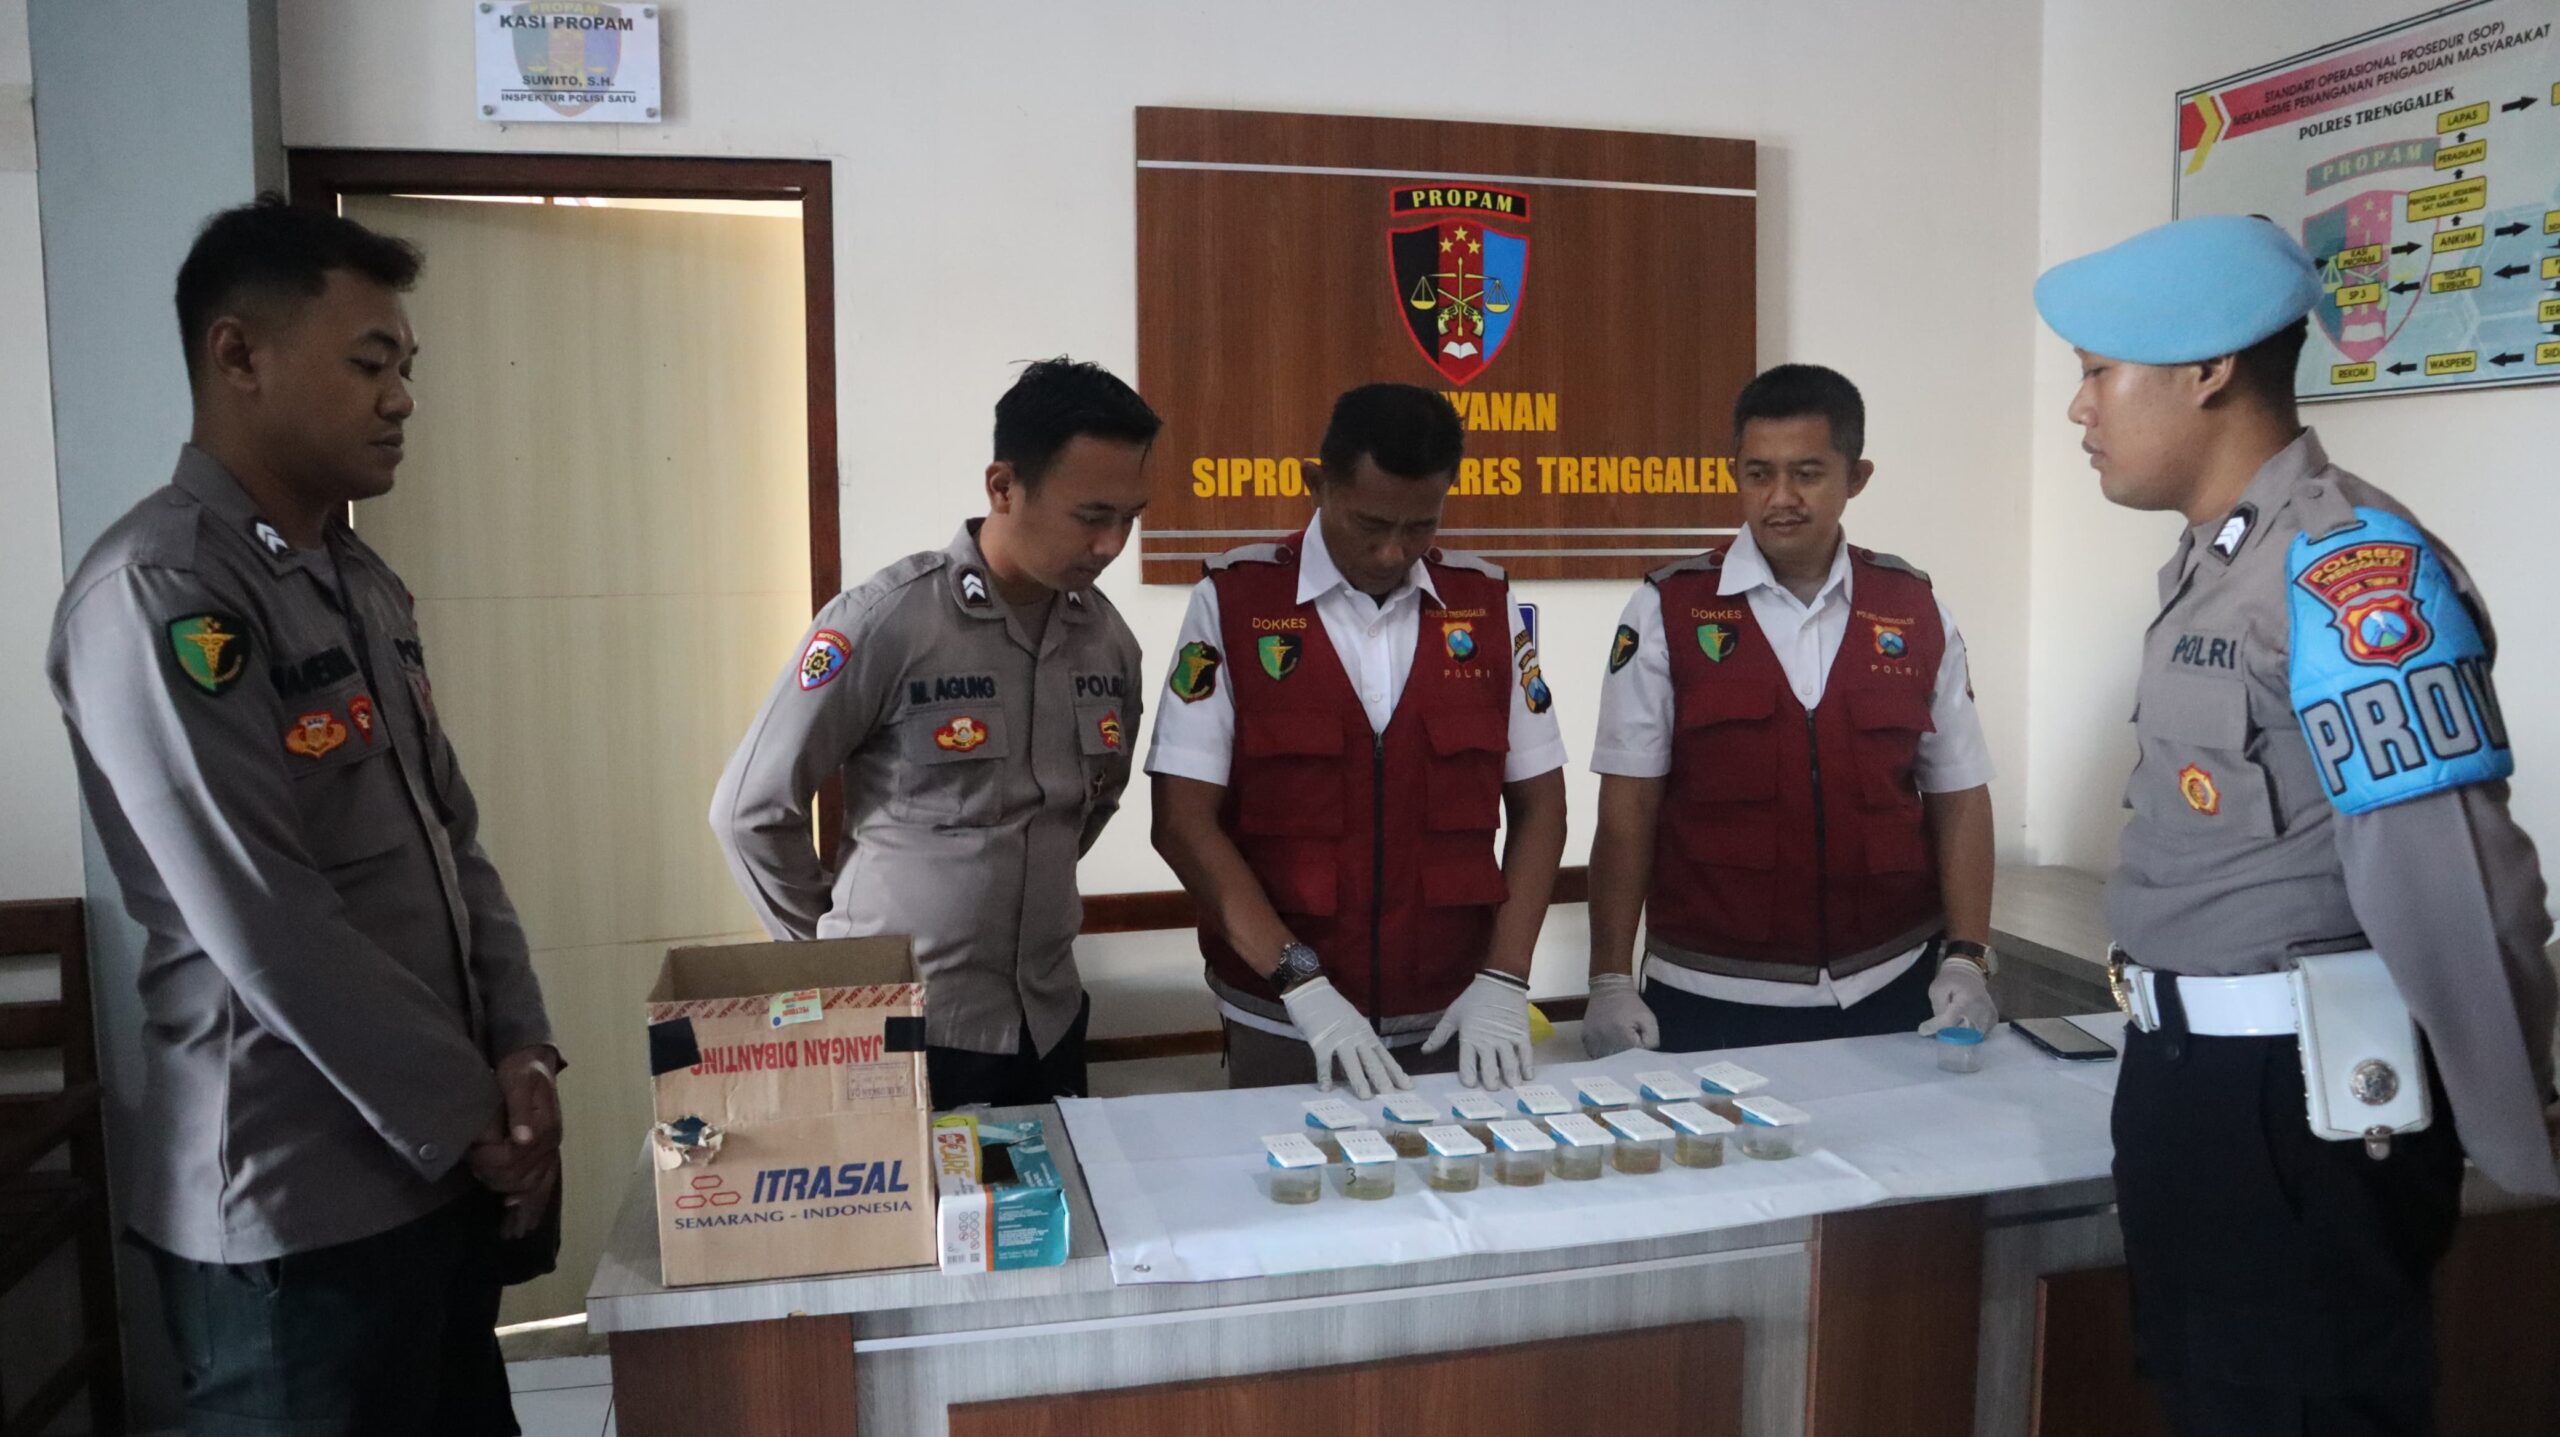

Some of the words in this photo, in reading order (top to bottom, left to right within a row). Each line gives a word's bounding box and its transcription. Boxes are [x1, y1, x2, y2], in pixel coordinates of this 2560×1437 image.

[500, 15, 546, 29] KASI
[553, 16, 634, 32] PROPAM
[2232, 100, 2291, 127] MEKANISME
[2294, 78, 2374, 110] PENANGANAN
[2376, 54, 2455, 86] PENGADUAN
[2457, 23, 2552, 63] MASYARAKAT
[2264, 78, 2316, 104] STANDART
[2317, 54, 2397, 88] OPERASIONAL
[2400, 32, 2464, 63] PROSEDUR
[2467, 20, 2506, 44] (SOP)
[522, 75, 583, 88] SUWITO,
[587, 76, 615, 87] S.H.
[501, 93, 566, 103] INSPEKTUR
[568, 94, 604, 103] POLISI
[607, 94, 637, 104] SATU
[2298, 114, 2353, 141] POLRES
[2355, 85, 2456, 126] TRENGGALEK
[2447, 109, 2479, 126] LAPAS
[2322, 142, 2423, 181] PROPAM
[1412, 188, 1514, 213] PROPAM
[1440, 390, 1557, 431] YANAN
[1192, 456, 1321, 497] SIPRO
[1536, 455, 1739, 494] TRENGGALEK
[2309, 547, 2406, 583] POLRES
[1252, 617, 1308, 631] DOKKES
[1691, 607, 1743, 620] DOKKES
[2171, 634, 2237, 670] POLRI
[1444, 669, 1490, 679] POLRI
[1870, 664, 1919, 677] POLRI
[803, 1034, 883, 1068] JANGAN
[751, 1159, 910, 1205] ITRASAL
[1345, 1167, 1357, 1186] 3
[674, 1210, 785, 1231] SEMARANG
[803, 1200, 913, 1220] INDONESIA
